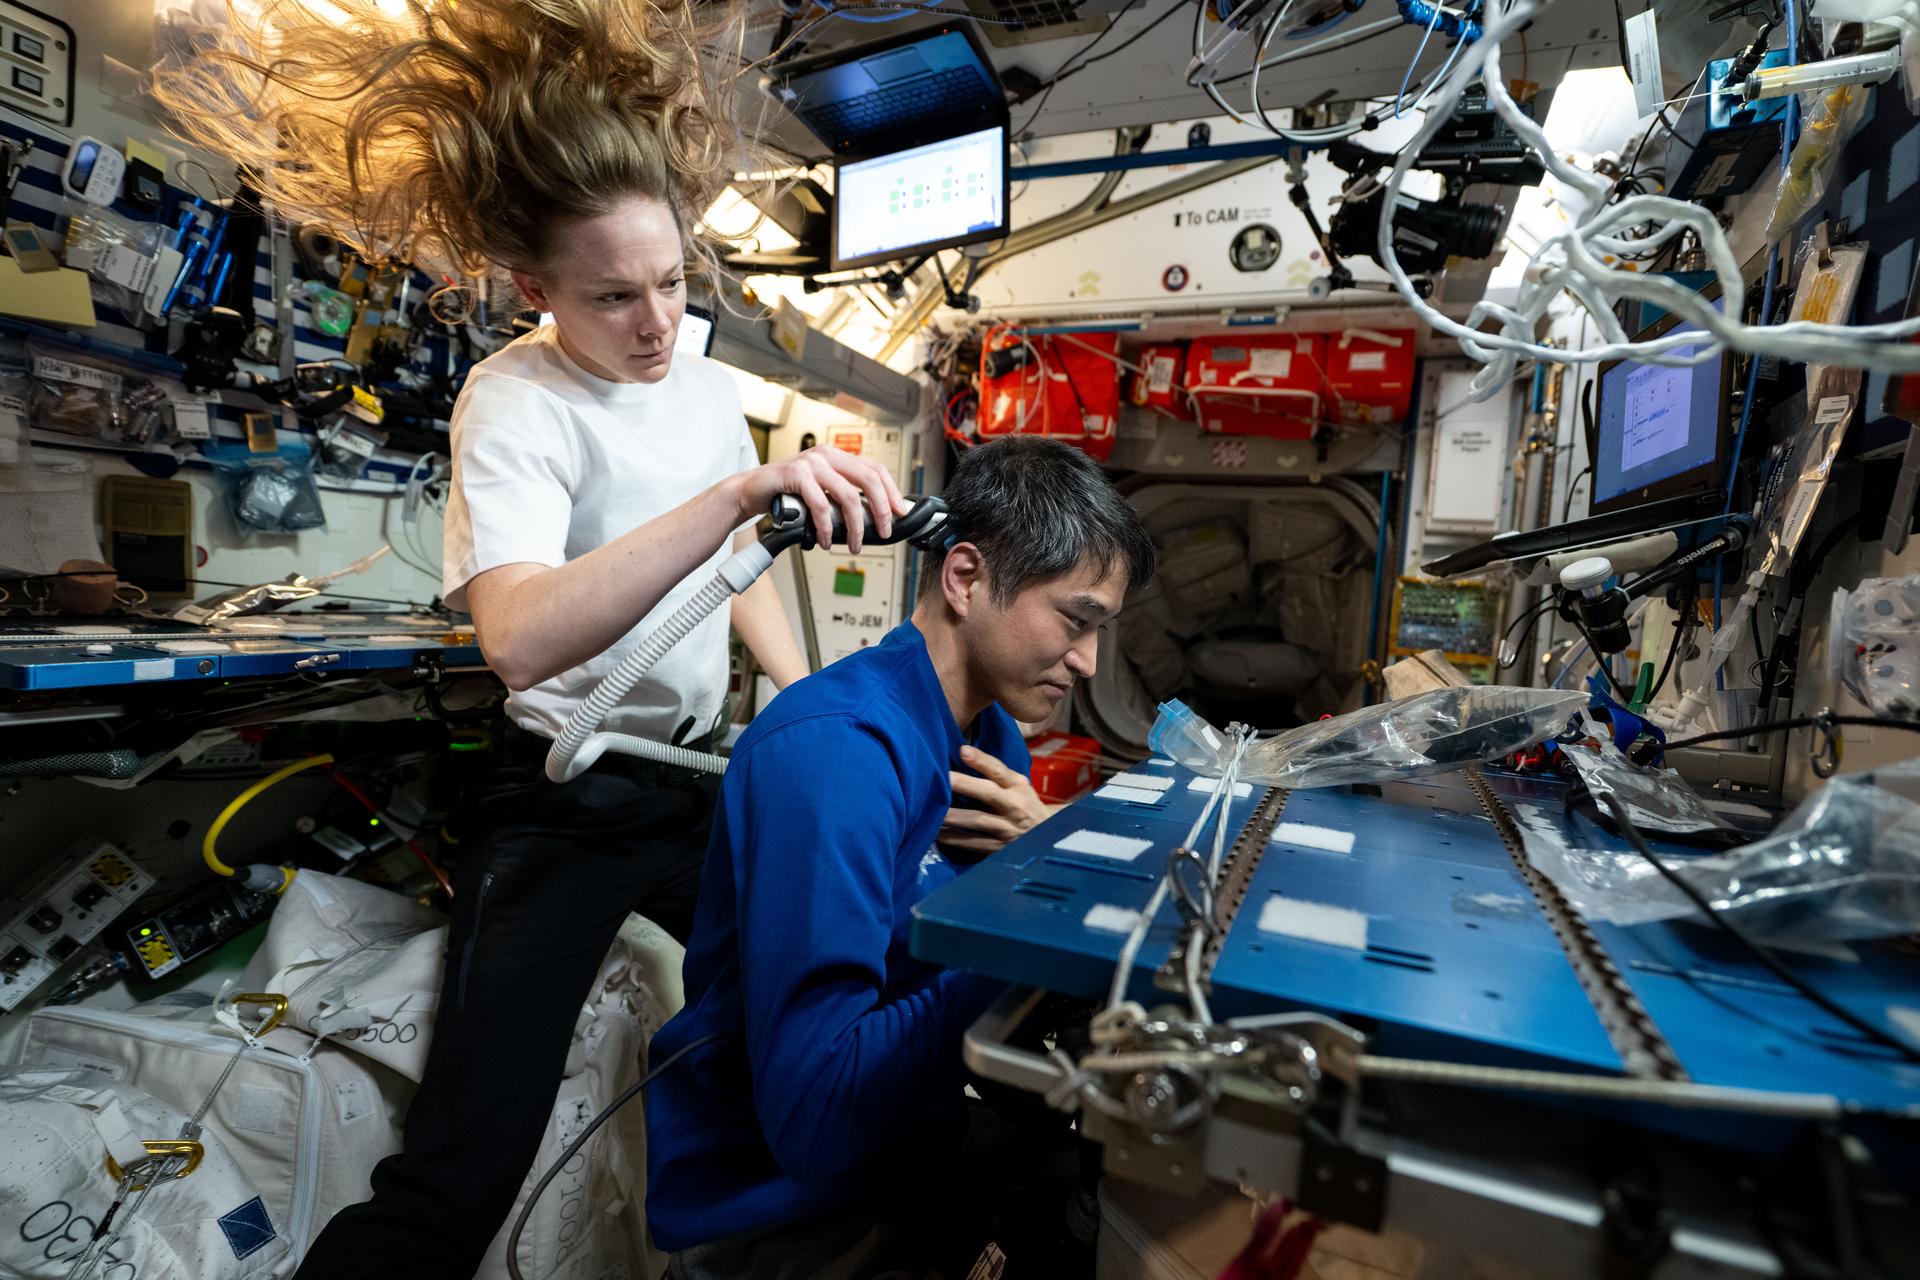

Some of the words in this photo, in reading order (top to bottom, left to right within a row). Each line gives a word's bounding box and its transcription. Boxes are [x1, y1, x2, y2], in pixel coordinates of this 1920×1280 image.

[1186, 211, 1202, 225] To
[1206, 207, 1239, 224] CAM
[1677, 538, 1724, 565] Manfrotto
[844, 612, 856, 626] To
[859, 614, 883, 627] JEM
